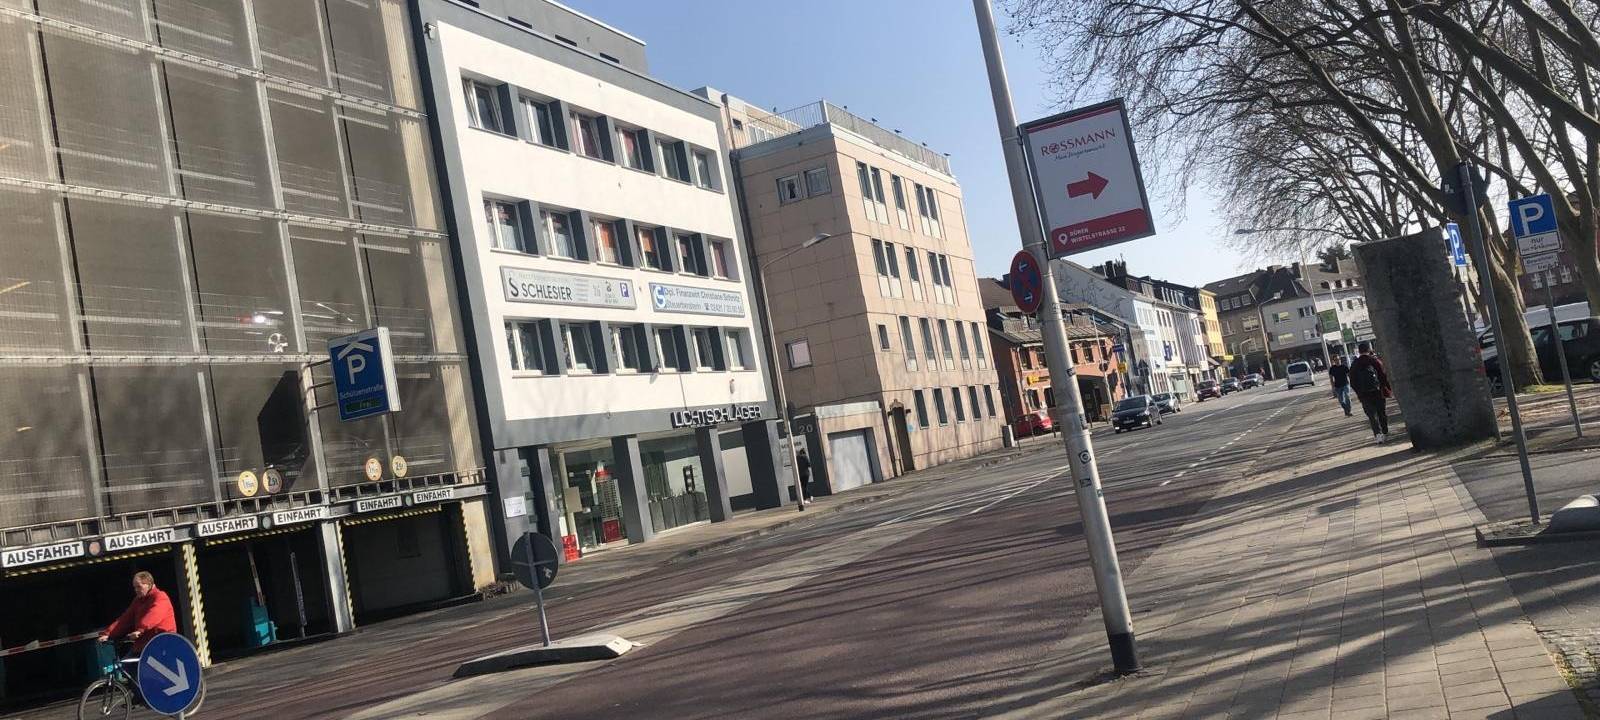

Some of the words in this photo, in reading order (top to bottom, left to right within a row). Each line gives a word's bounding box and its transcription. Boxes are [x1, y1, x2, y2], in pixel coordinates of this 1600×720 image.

[1041, 128, 1116, 157] ROSSMANN
[1518, 202, 1544, 235] P
[1071, 228, 1118, 244] WIRTELSTRASSE
[521, 282, 573, 301] SCHLESIER
[346, 353, 366, 385] P
[359, 498, 400, 511] EINFAHRT
[415, 489, 452, 503] EINFAHRT
[277, 508, 323, 523] EINFAHRT
[201, 517, 256, 535] AUSFAHRT
[109, 530, 172, 549] AUSFAHRT
[7, 543, 81, 565] AUSFAHRT
